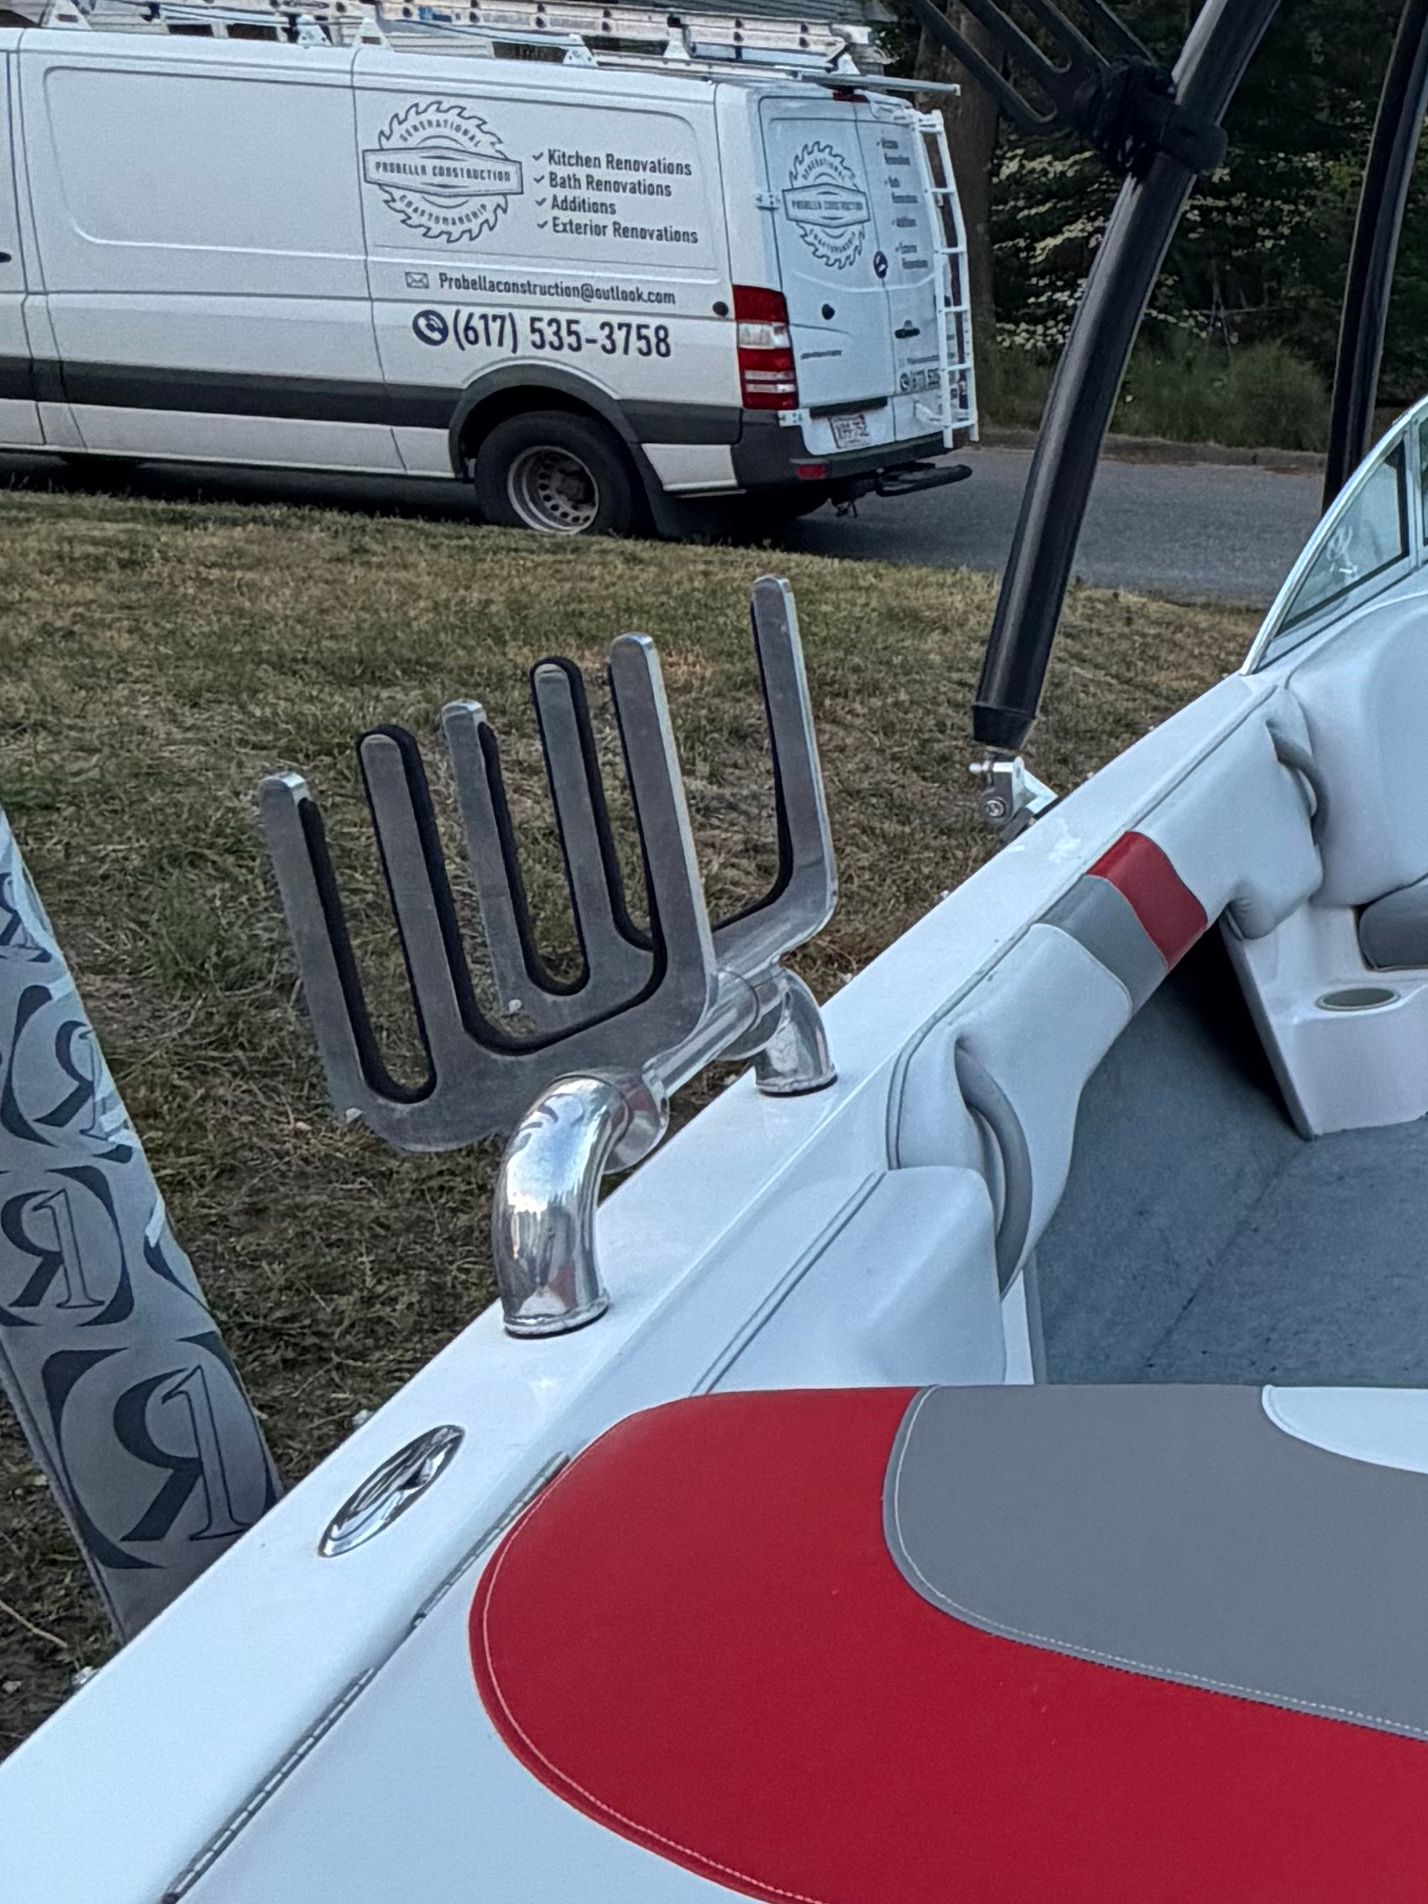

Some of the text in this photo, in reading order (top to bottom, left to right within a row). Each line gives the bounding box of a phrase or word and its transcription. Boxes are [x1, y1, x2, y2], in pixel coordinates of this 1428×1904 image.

[399, 118, 481, 147] GENERATIONAL
[375, 161, 512, 182] PROBELLA CONSTRUCTION
[548, 148, 693, 176] Kitchen Renovations
[549, 171, 672, 198] Bath Renovations
[551, 193, 616, 216] Additions
[552, 216, 699, 244] Exterior Renovations
[438, 272, 676, 306] Probellaconstruction@outlook.com
[453, 309, 672, 358] (617) 535-3758
